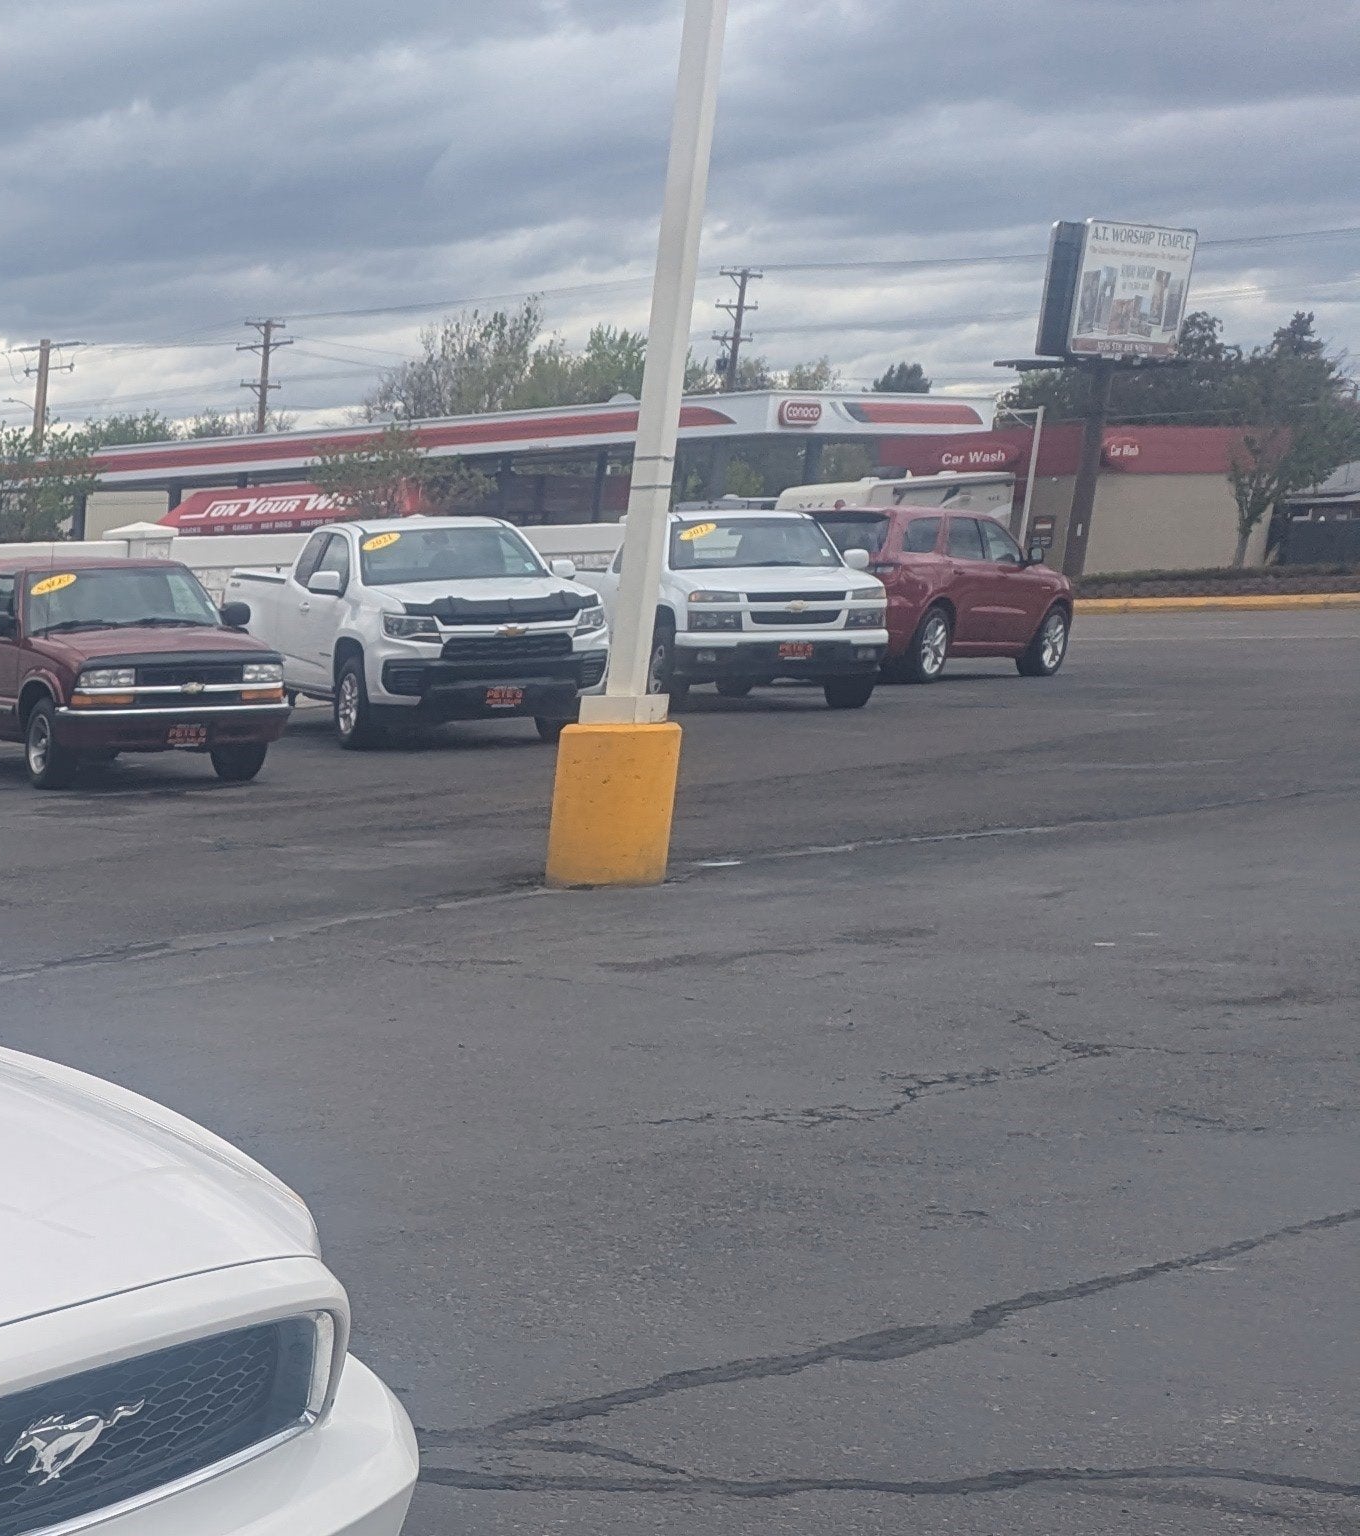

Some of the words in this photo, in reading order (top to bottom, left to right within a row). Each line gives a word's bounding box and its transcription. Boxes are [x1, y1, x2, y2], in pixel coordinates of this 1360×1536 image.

[1112, 228, 1156, 246] WORSHIP
[1158, 232, 1192, 250] TEMPLE
[941, 452, 965, 465] Car
[968, 450, 1006, 464] Wash
